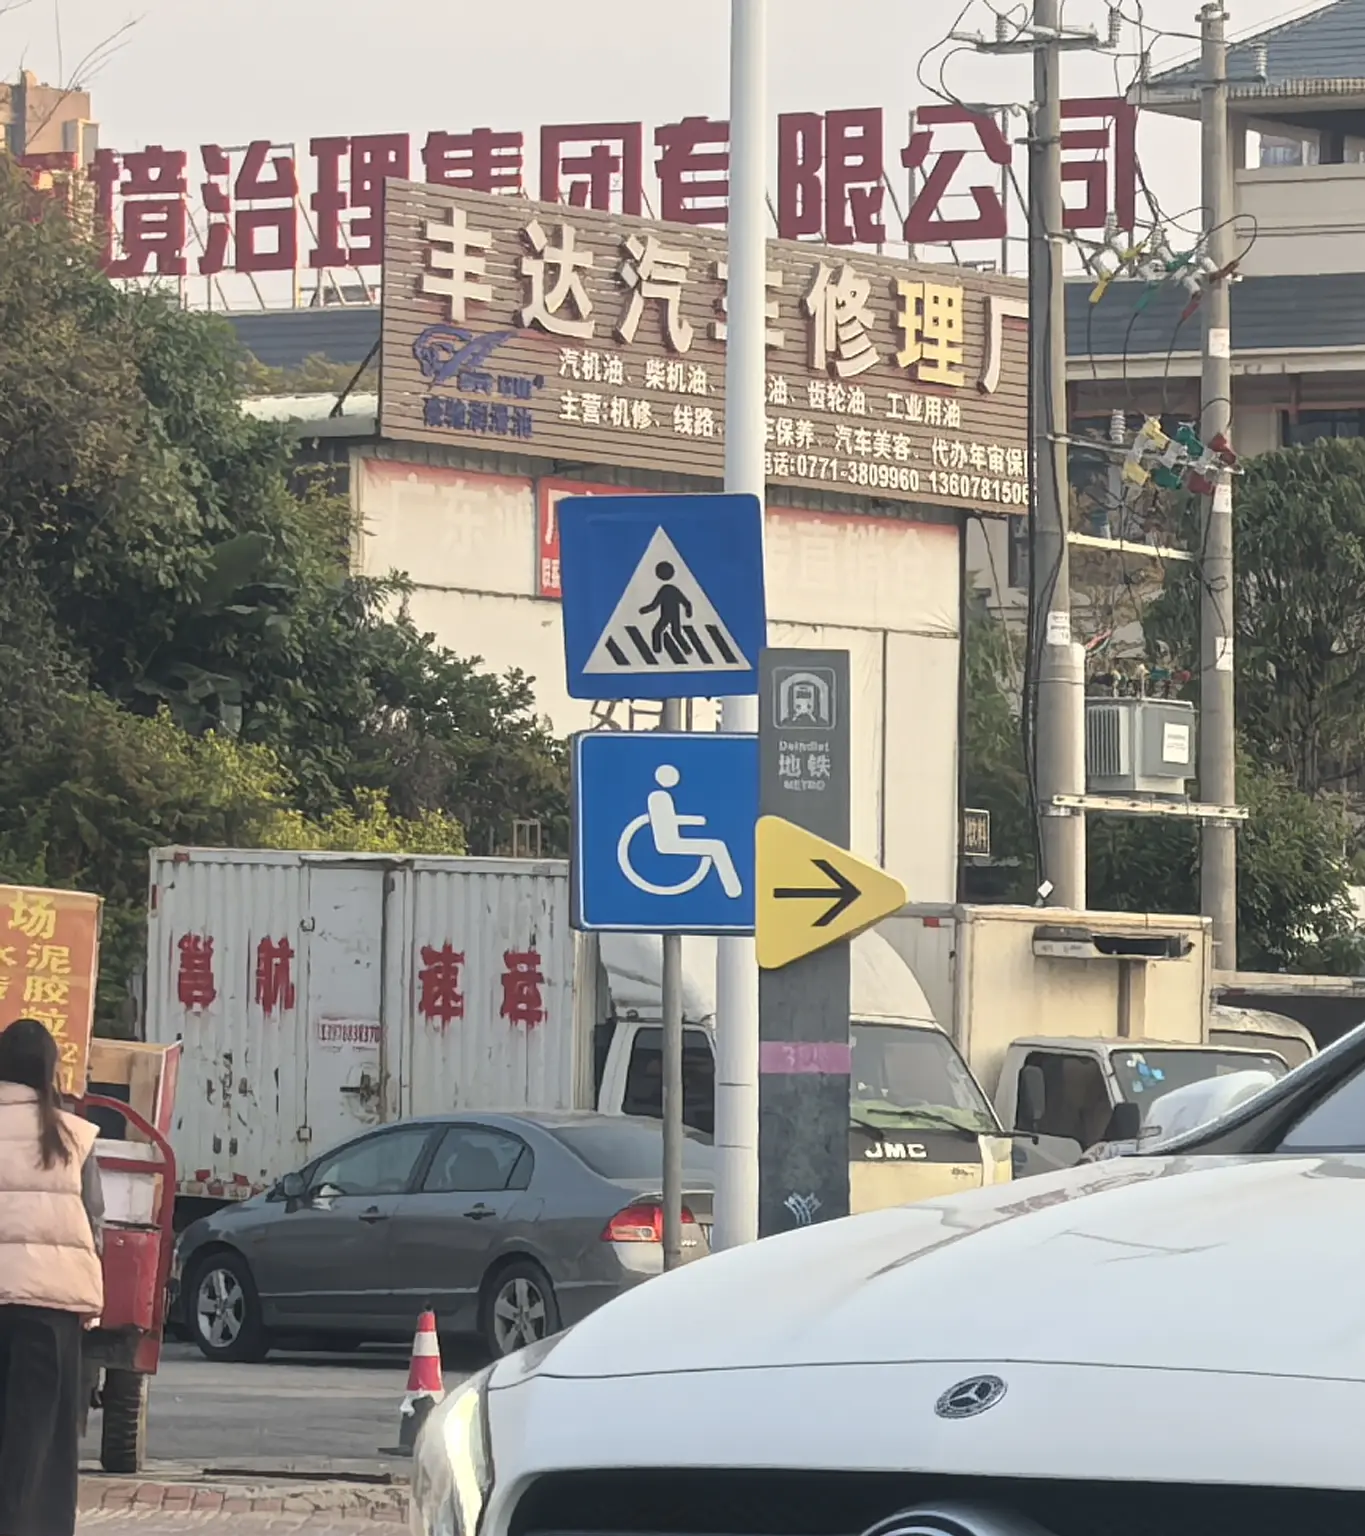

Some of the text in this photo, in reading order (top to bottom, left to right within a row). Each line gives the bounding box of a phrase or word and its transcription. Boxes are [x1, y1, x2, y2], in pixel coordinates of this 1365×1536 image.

[779, 753, 830, 779] 地铁
[783, 779, 826, 791] METRO
[865, 1142, 927, 1159] JMC
